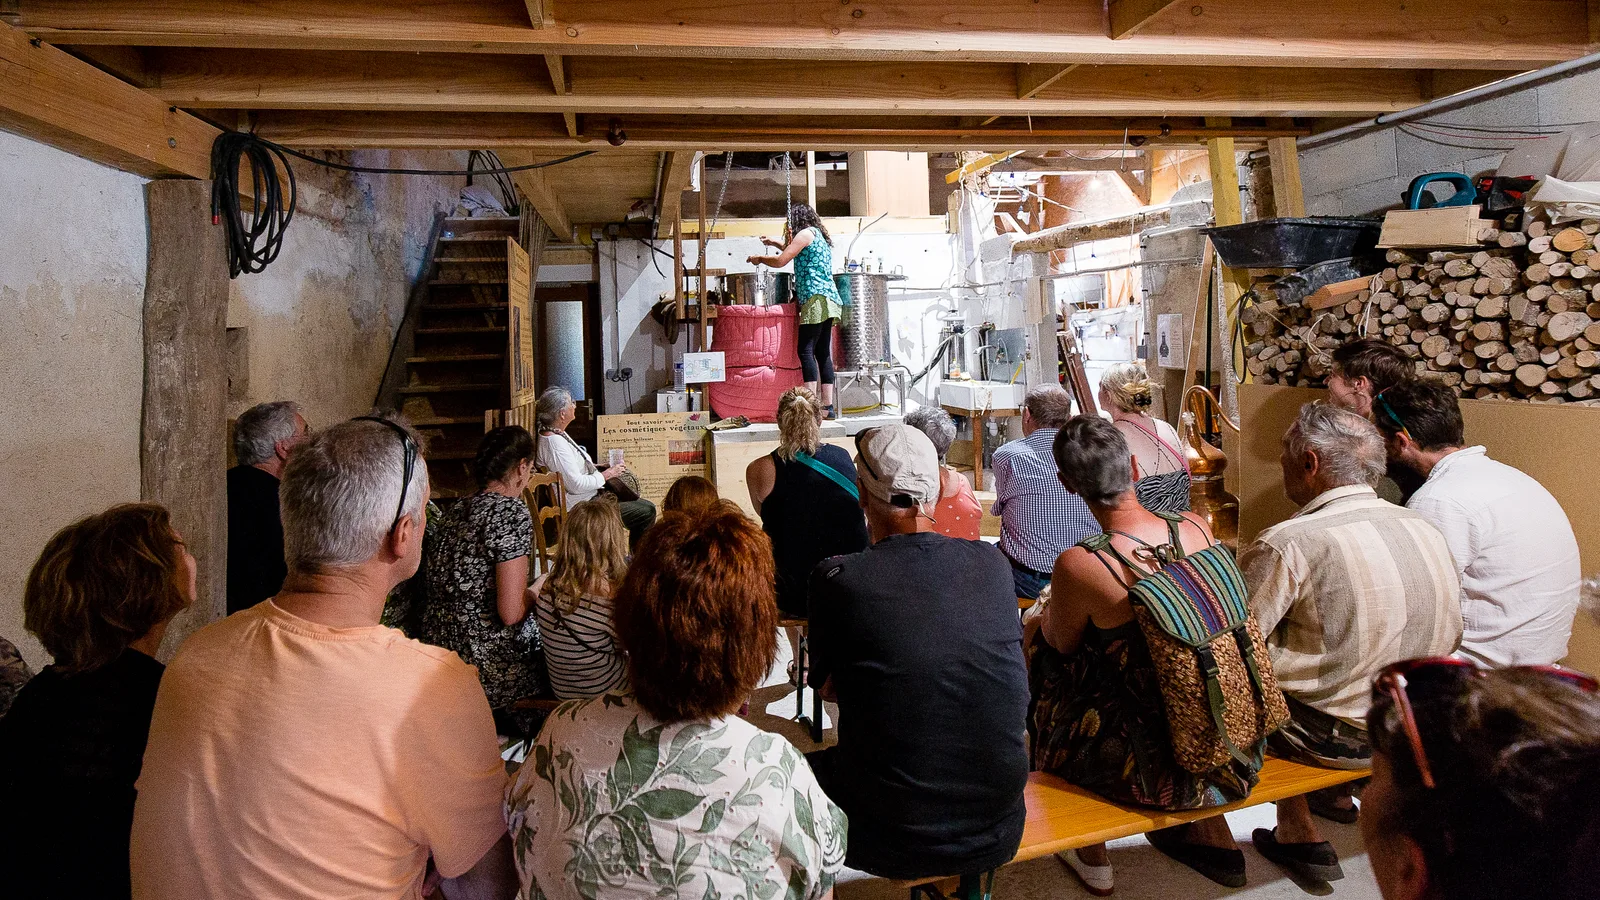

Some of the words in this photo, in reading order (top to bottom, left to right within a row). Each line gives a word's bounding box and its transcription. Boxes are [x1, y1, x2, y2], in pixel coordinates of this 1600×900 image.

[603, 427, 616, 435] Les
[619, 425, 666, 434] cosmétiques
[669, 424, 705, 432] végétaux
